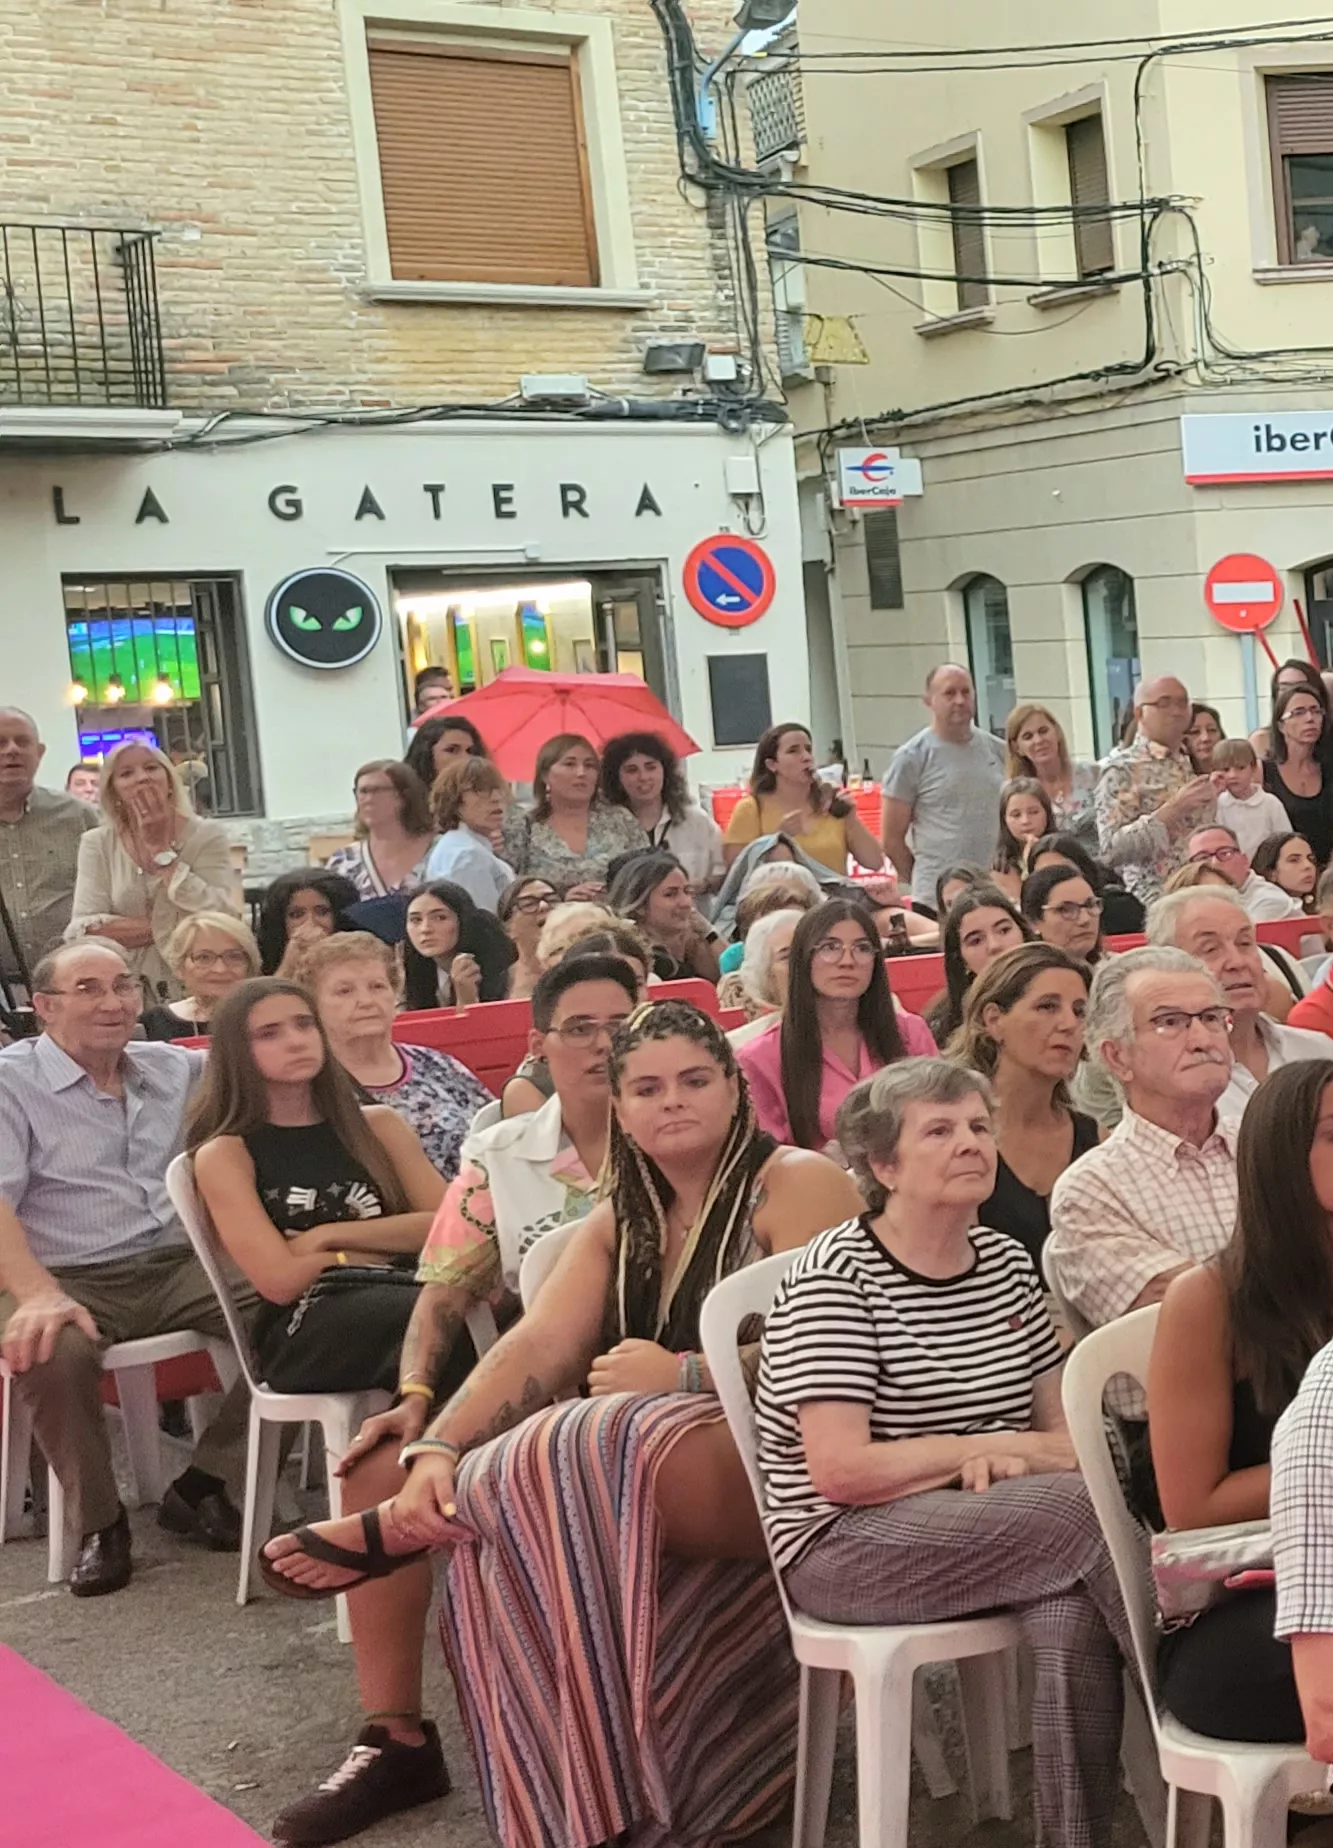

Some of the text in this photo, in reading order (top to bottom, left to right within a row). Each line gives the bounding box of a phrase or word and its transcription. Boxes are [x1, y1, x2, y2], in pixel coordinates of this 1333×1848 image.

[52, 482, 663, 524] LA GATERA
[849, 486, 896, 496] iberCaja
